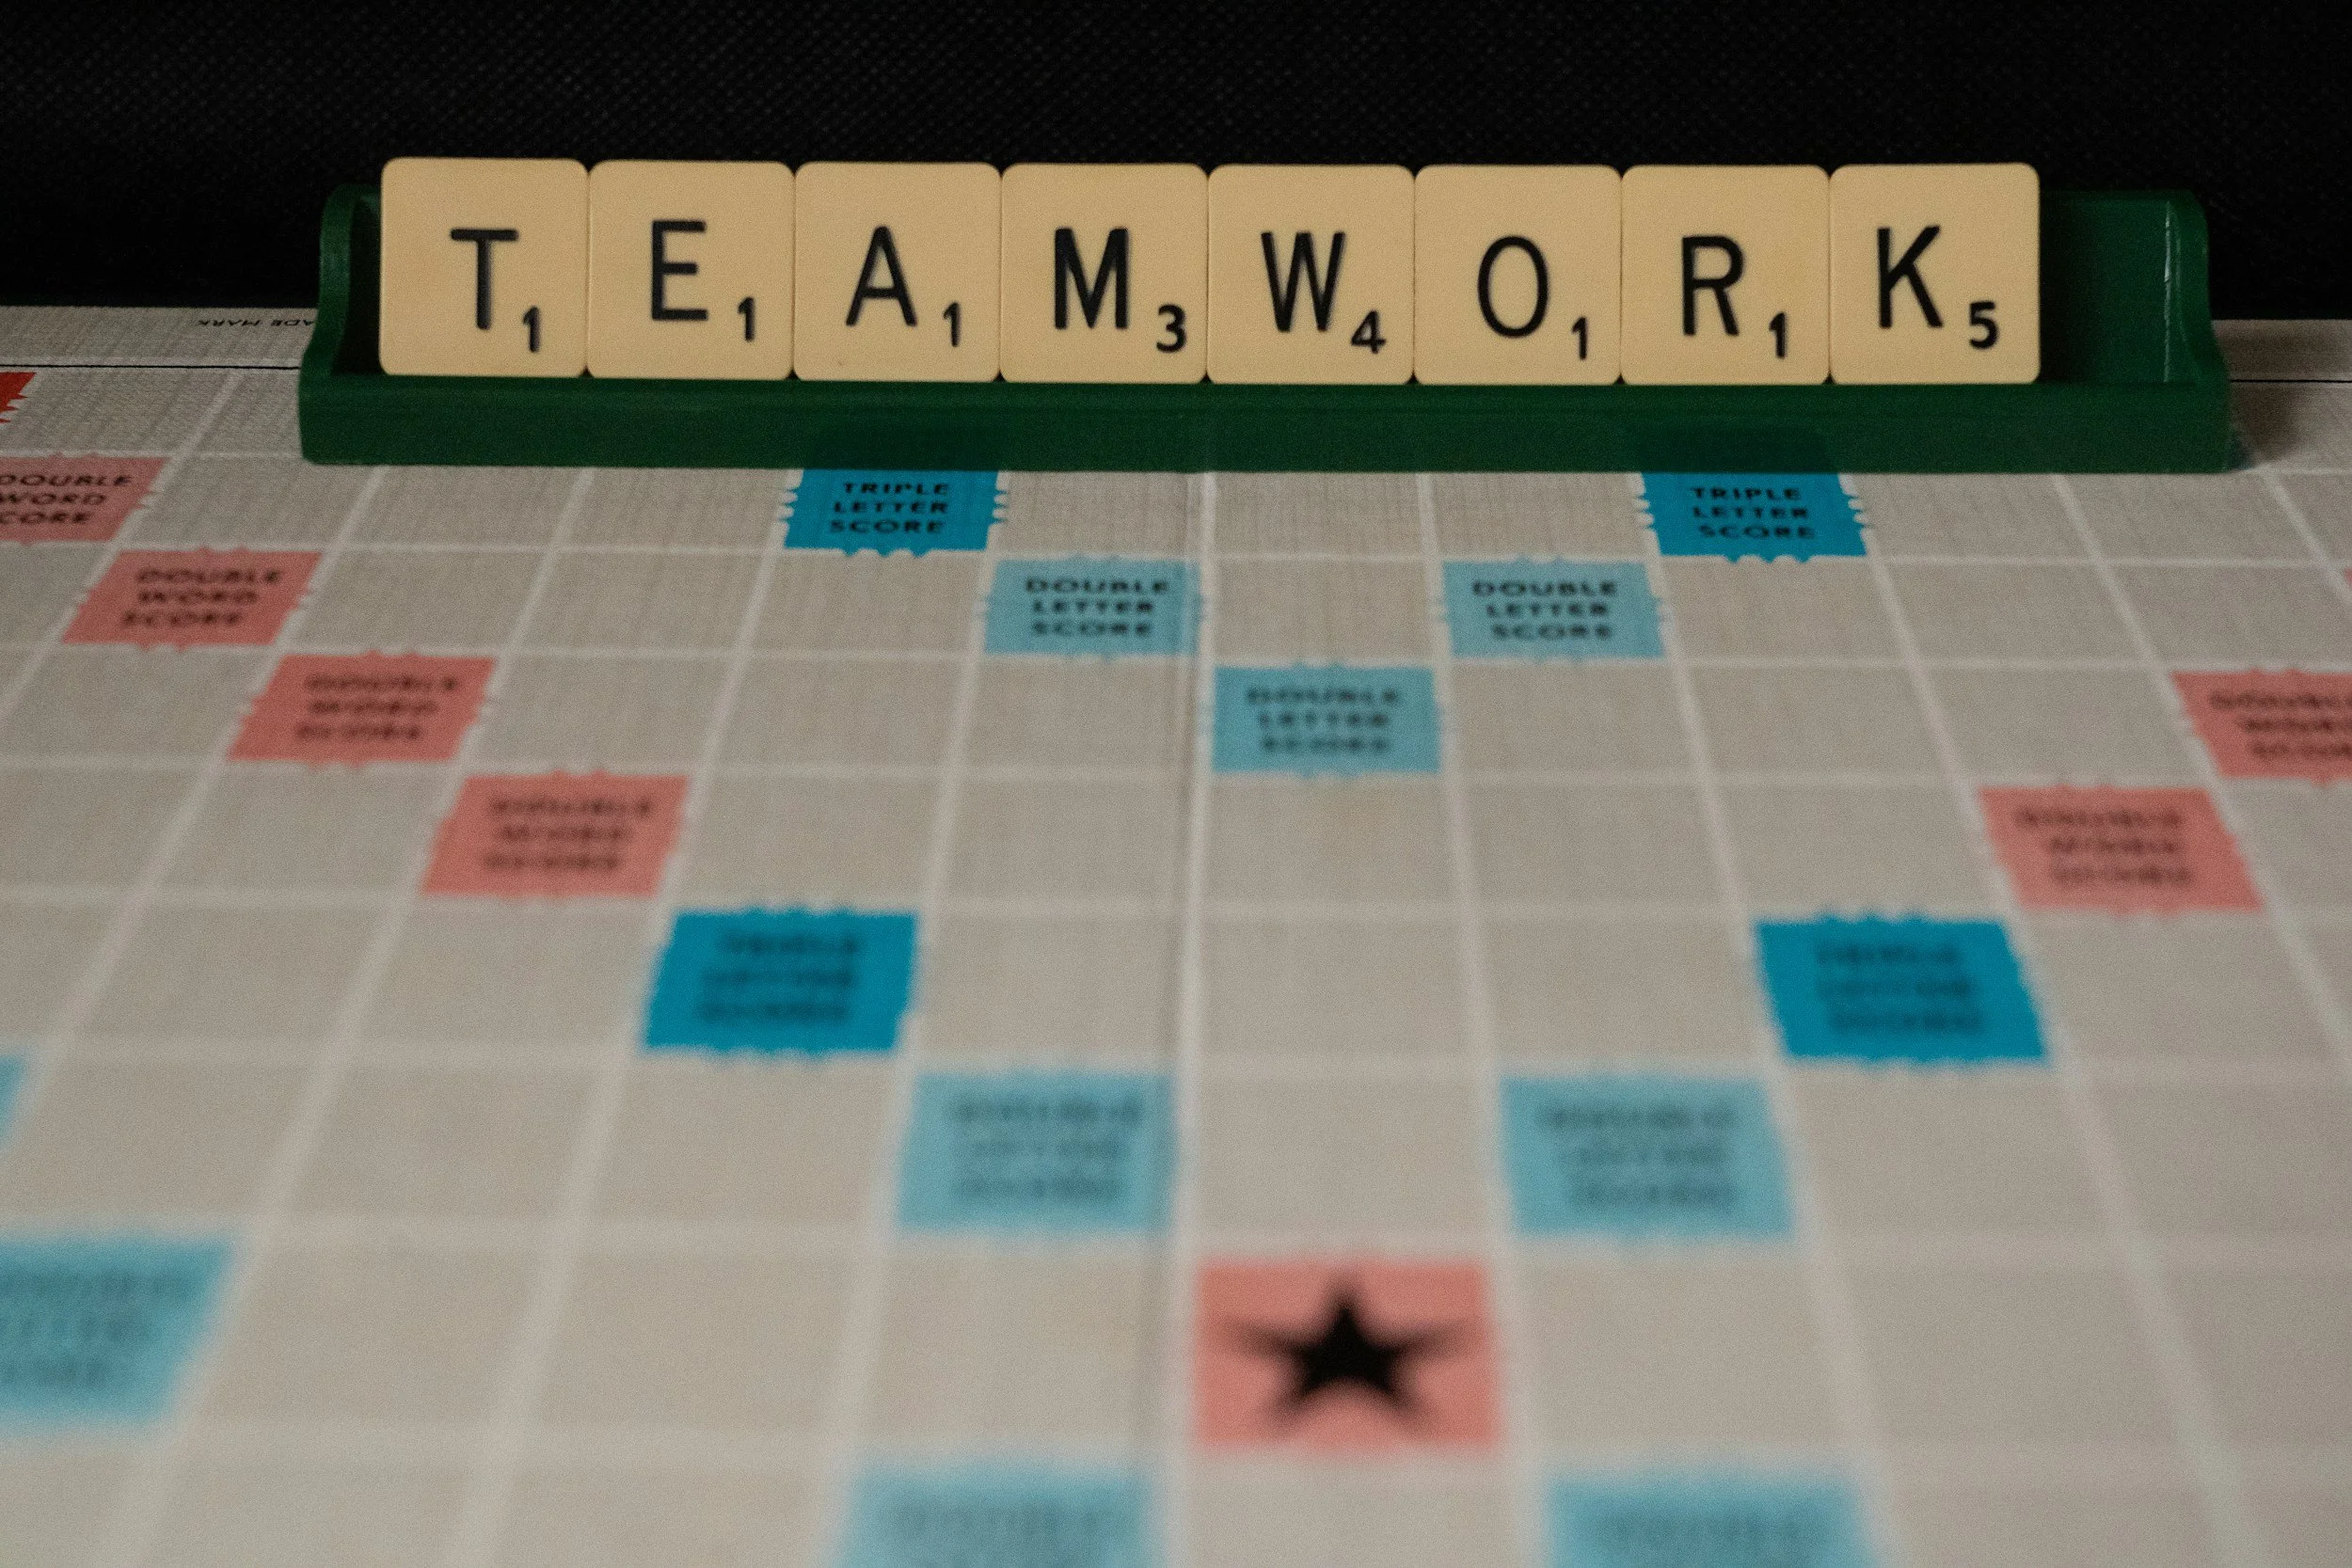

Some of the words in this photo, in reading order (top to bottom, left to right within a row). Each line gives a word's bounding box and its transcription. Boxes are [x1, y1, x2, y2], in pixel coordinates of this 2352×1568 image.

[843, 483, 950, 496] TRIPLE
[1690, 488, 1801, 500] TRIPLE
[834, 501, 949, 515] LETTER
[1692, 506, 1809, 519] LETTER
[0, 511, 92, 525] CORE
[829, 519, 946, 534] SCORE
[1698, 525, 1816, 540] SCORE
[1025, 577, 1170, 595] DOUBLE
[1472, 580, 1619, 597] DOUBLE
[1032, 599, 1155, 614] LETTER
[1486, 603, 1611, 618] LETTER
[1030, 621, 1152, 638] SCORE
[1490, 624, 1614, 641] SCORE
